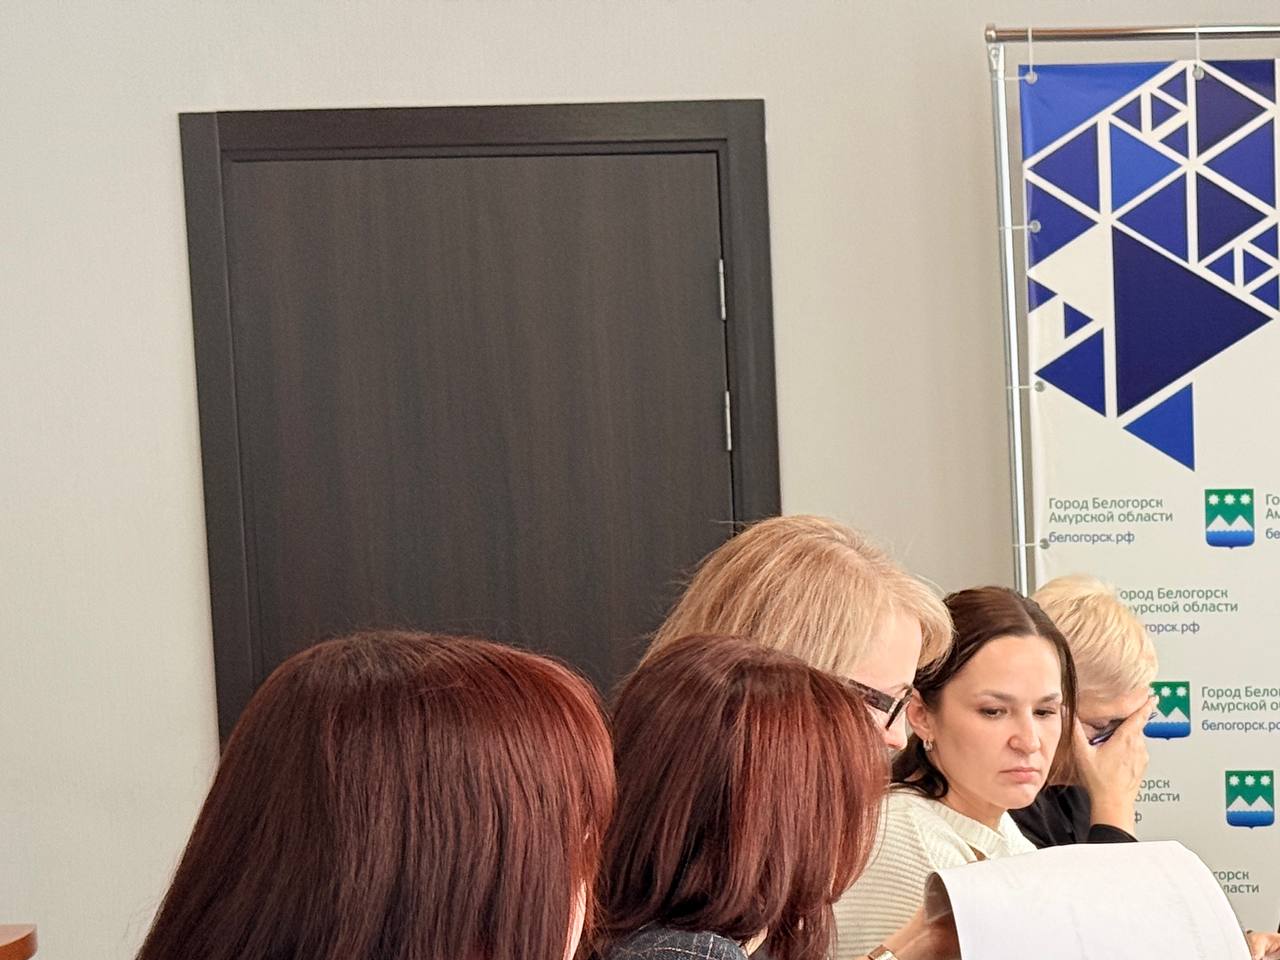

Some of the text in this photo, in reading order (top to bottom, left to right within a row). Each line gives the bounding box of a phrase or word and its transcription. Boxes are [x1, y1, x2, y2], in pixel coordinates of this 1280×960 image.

[1049, 499, 1163, 514] Город Белогорск
[1049, 511, 1173, 526] Амурской области
[1049, 530, 1134, 545] белогорск.рф
[1120, 589, 1228, 604] ород Белогорск
[1131, 602, 1238, 617] урской области
[1145, 620, 1199, 635] горск.рф
[1202, 687, 1241, 702] Город
[1202, 699, 1266, 714] Амурской
